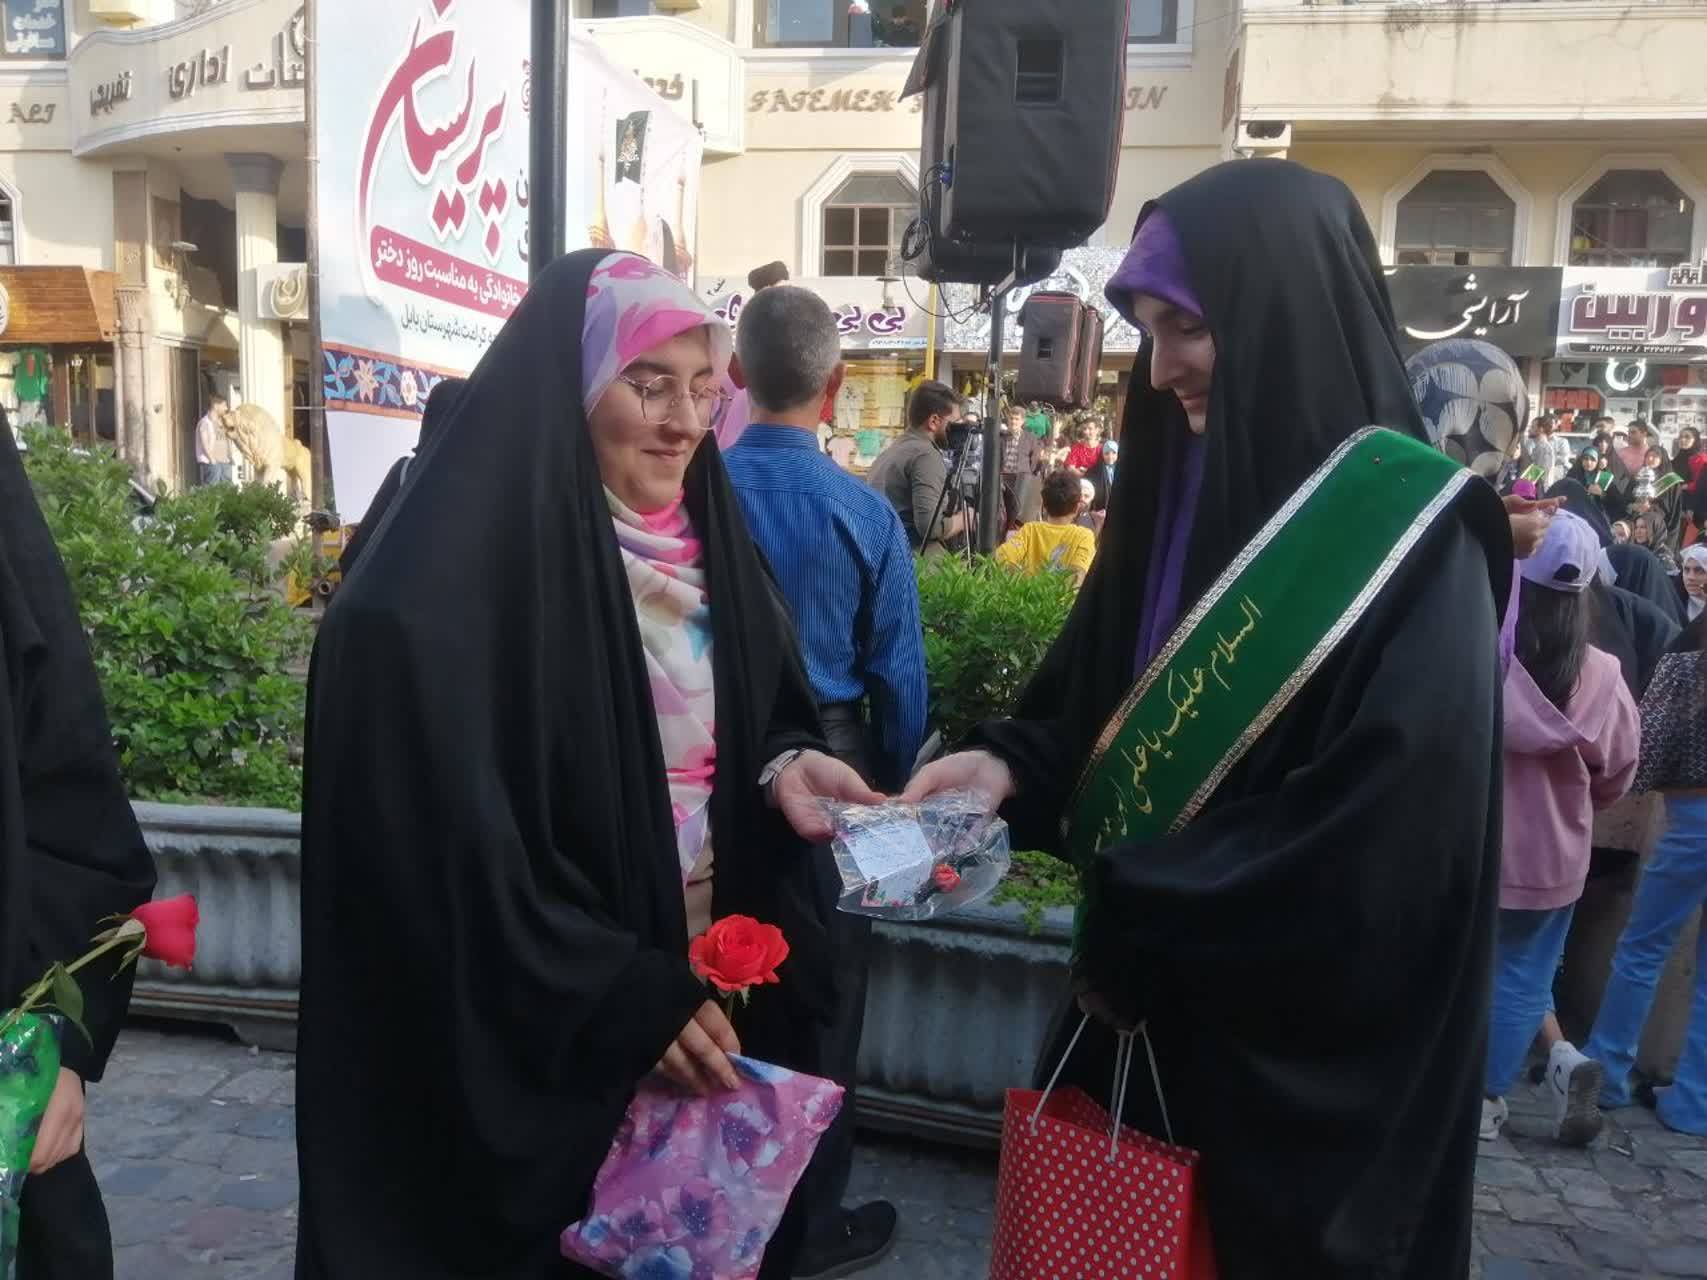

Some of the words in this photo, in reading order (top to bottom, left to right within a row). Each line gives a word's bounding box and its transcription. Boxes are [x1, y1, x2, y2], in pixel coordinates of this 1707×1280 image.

[168, 45, 232, 99] اداری
[375, 238, 404, 268] دختر
[405, 249, 423, 282] روز
[424, 260, 467, 290] مناسبت
[467, 278, 479, 301] به
[1405, 273, 1529, 340] آرایشی
[1569, 282, 1707, 341] وربین
[1211, 594, 1263, 691] السلام
[1162, 668, 1204, 737] علیک
